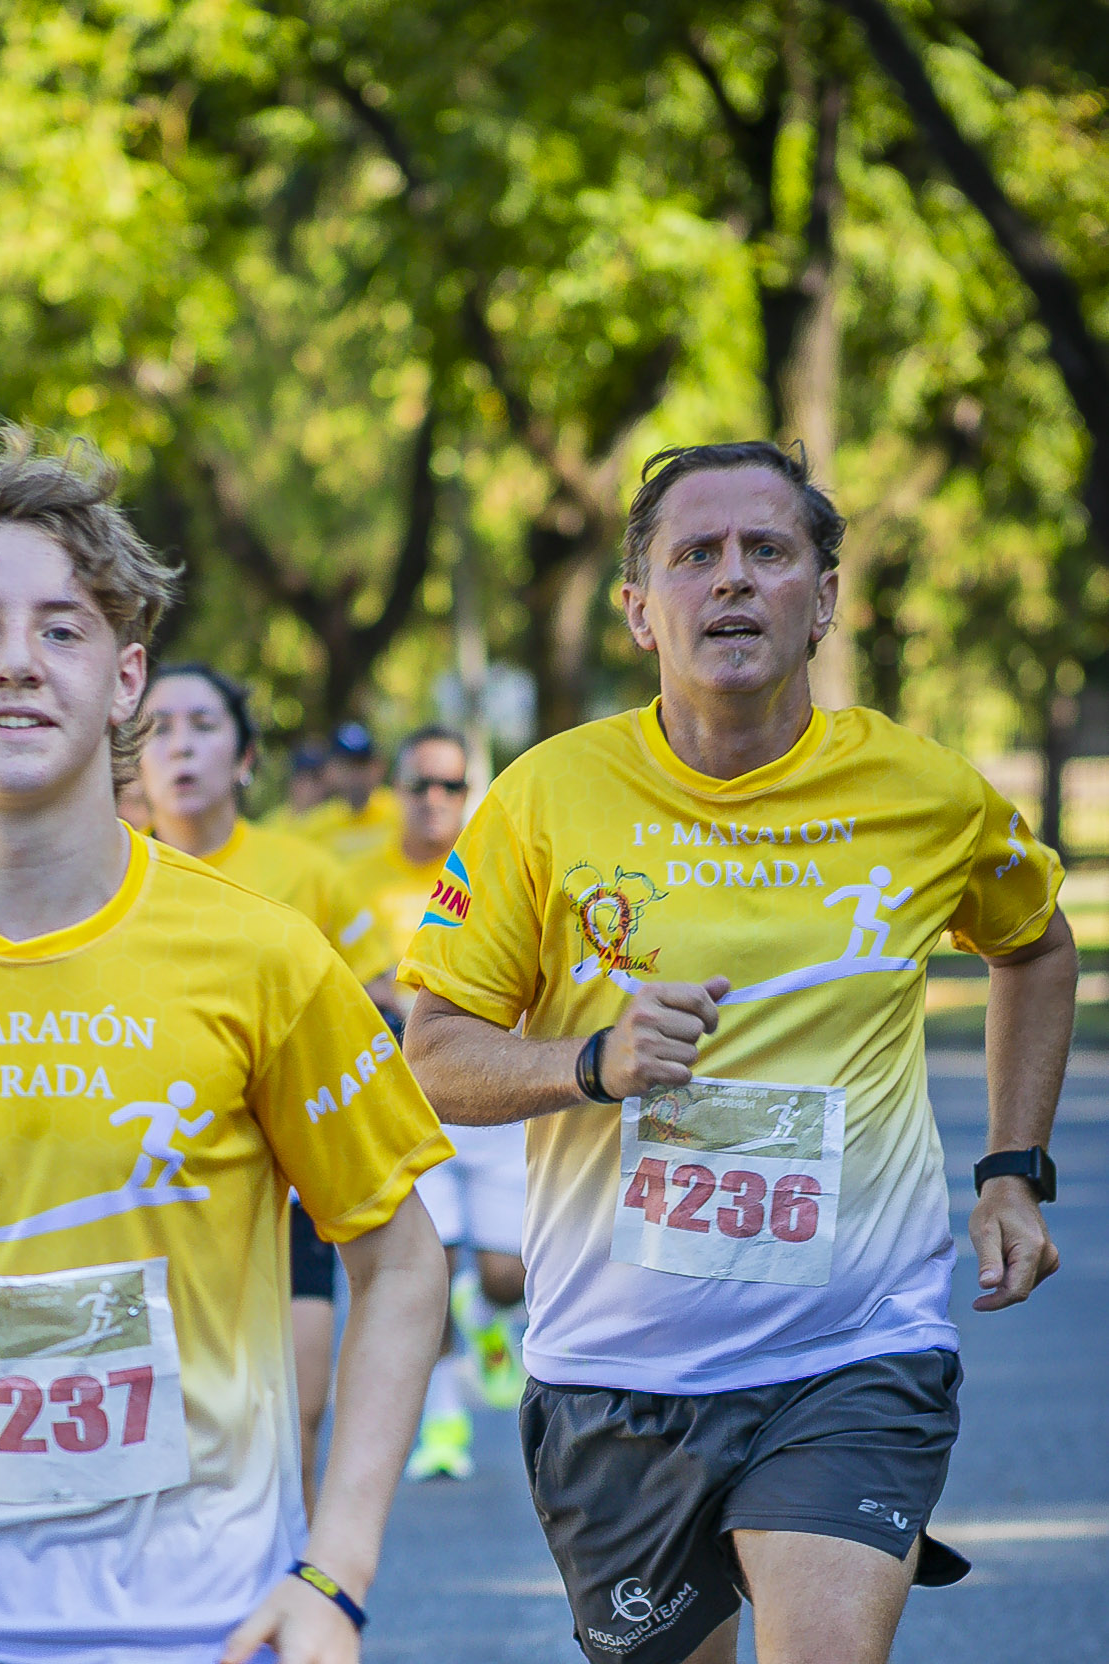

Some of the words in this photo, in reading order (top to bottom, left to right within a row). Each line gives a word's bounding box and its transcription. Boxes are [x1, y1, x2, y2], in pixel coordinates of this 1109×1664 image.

[666, 860, 825, 888] DORADA
[304, 1030, 395, 1124] MARS
[624, 1157, 822, 1243] 4236
[651, 1582, 693, 1623] TEAM
